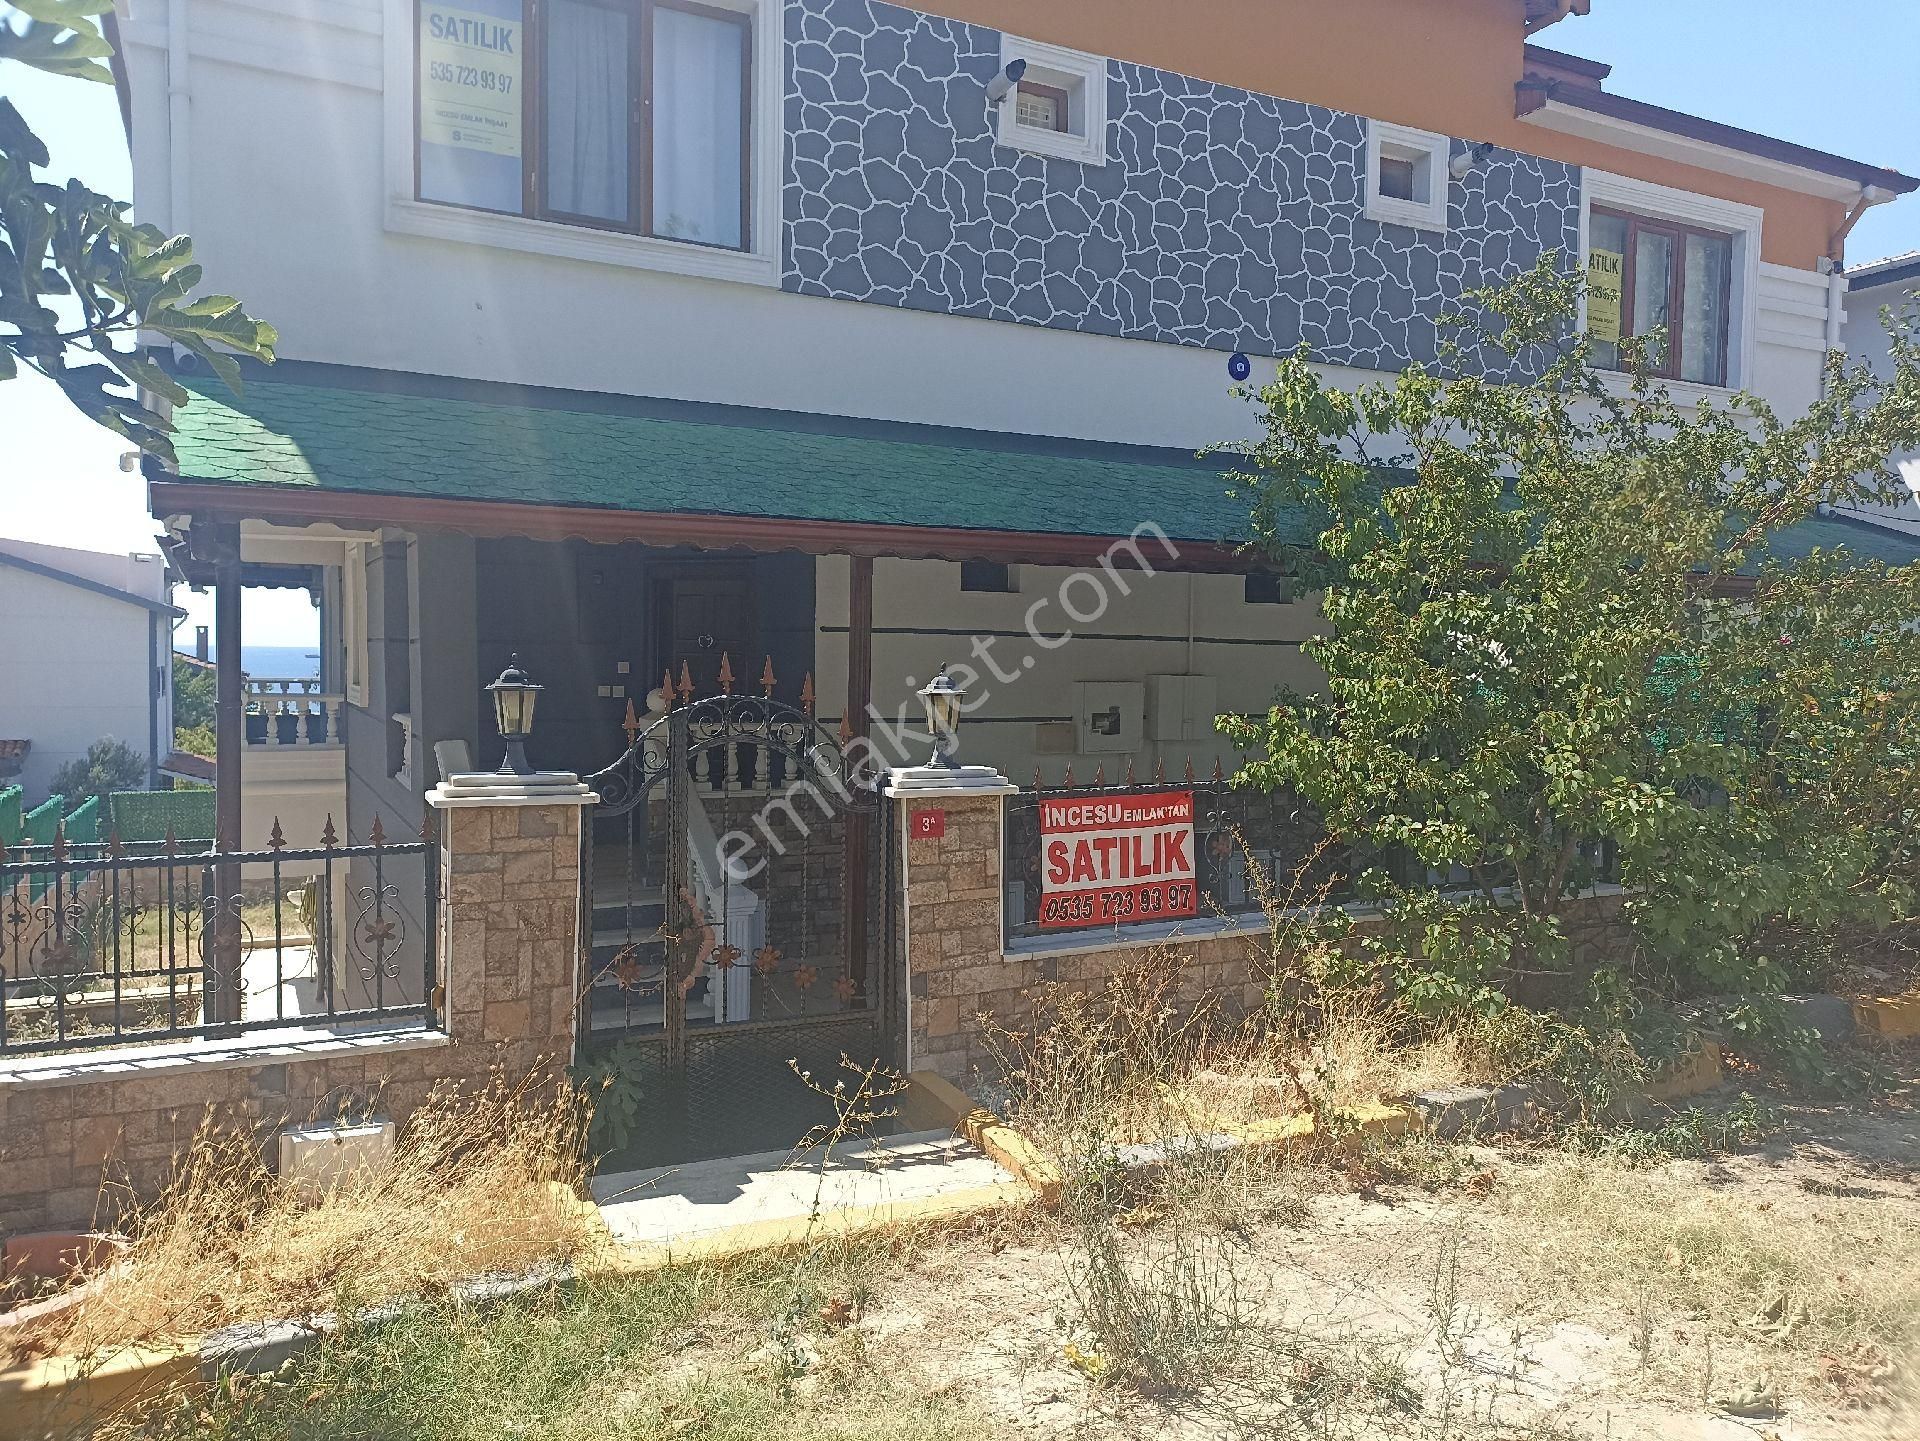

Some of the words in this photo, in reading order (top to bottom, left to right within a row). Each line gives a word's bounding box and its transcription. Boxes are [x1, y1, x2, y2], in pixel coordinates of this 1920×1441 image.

[430, 13, 513, 54] SATILIK
[430, 61, 453, 83] 535
[456, 65, 478, 87] 723
[481, 70, 496, 91] 93
[498, 73, 513, 94] 97
[1588, 253, 1619, 275] ATILIK
[1044, 803, 1122, 828] İNCESU
[1123, 803, 1189, 822] EMLAK'TAN
[1047, 829, 1191, 885] SATILIK
[1045, 894, 1094, 921] 0535
[1100, 890, 1135, 918] 723
[1140, 886, 1163, 913] 93
[1167, 884, 1192, 910] 97
